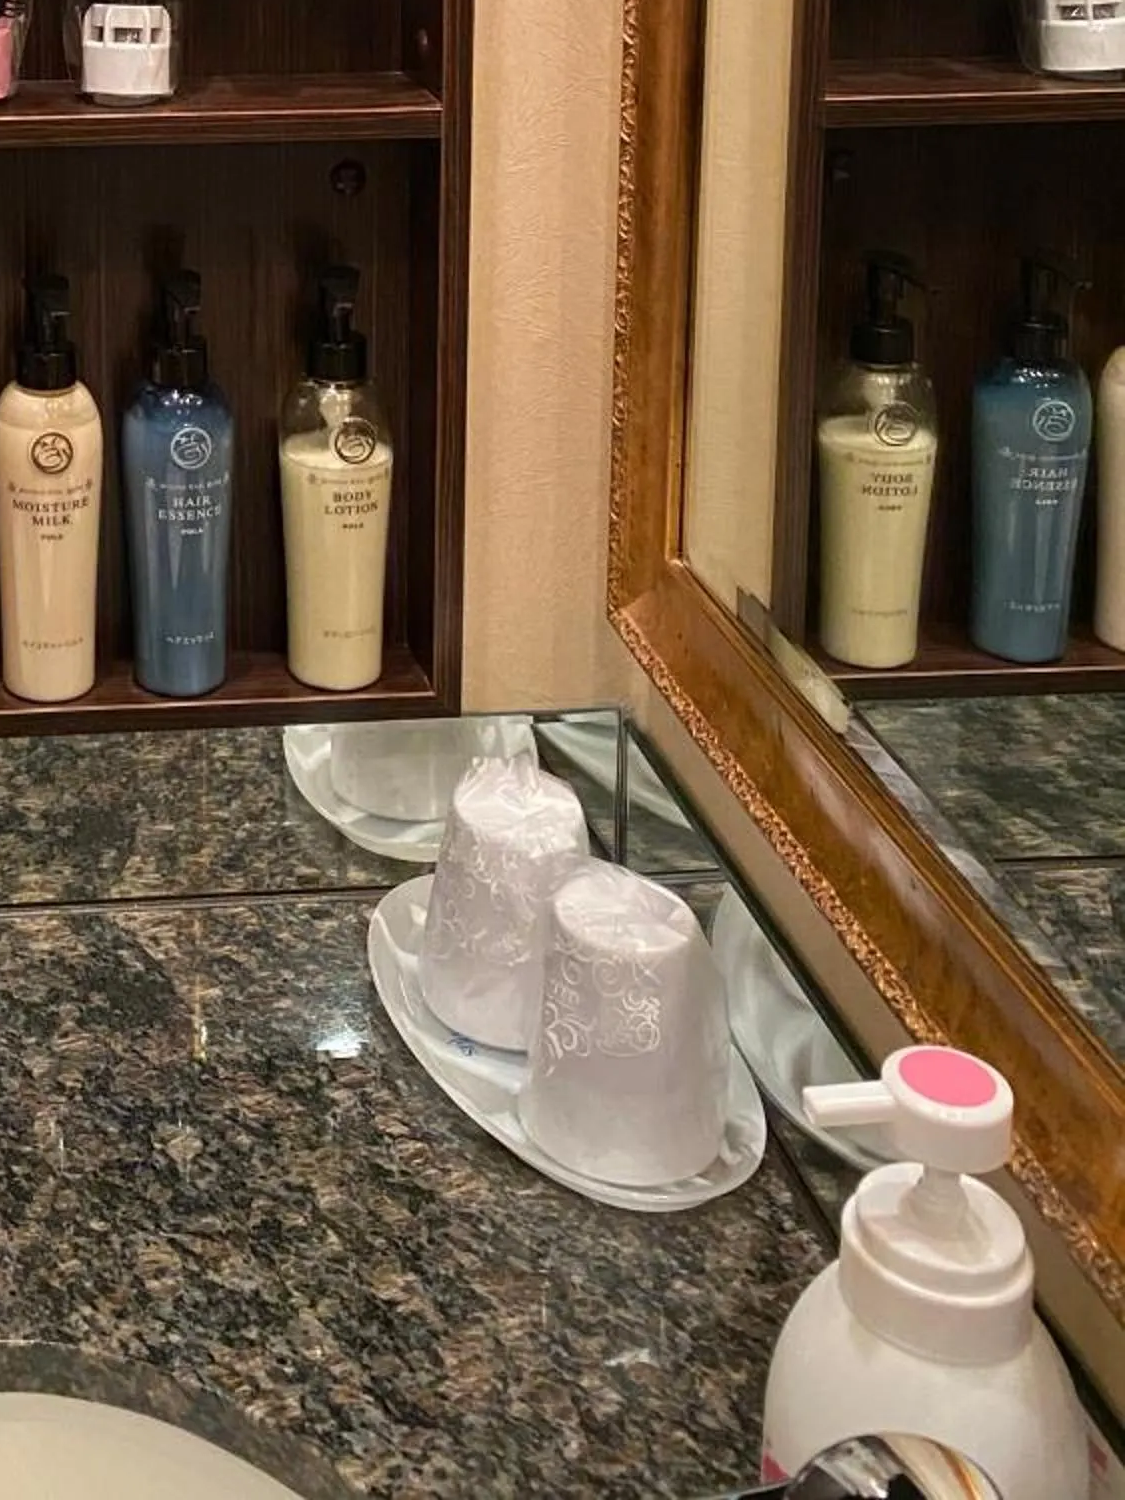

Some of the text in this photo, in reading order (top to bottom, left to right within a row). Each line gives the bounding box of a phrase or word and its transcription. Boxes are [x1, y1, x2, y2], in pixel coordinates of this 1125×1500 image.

[173, 495, 212, 508] HAIR
[333, 490, 372, 503] BODY
[12, 496, 89, 513] MOISTURE
[324, 500, 378, 516] LOTION
[158, 504, 222, 521] ESSENCE
[32, 514, 73, 527] MILK
